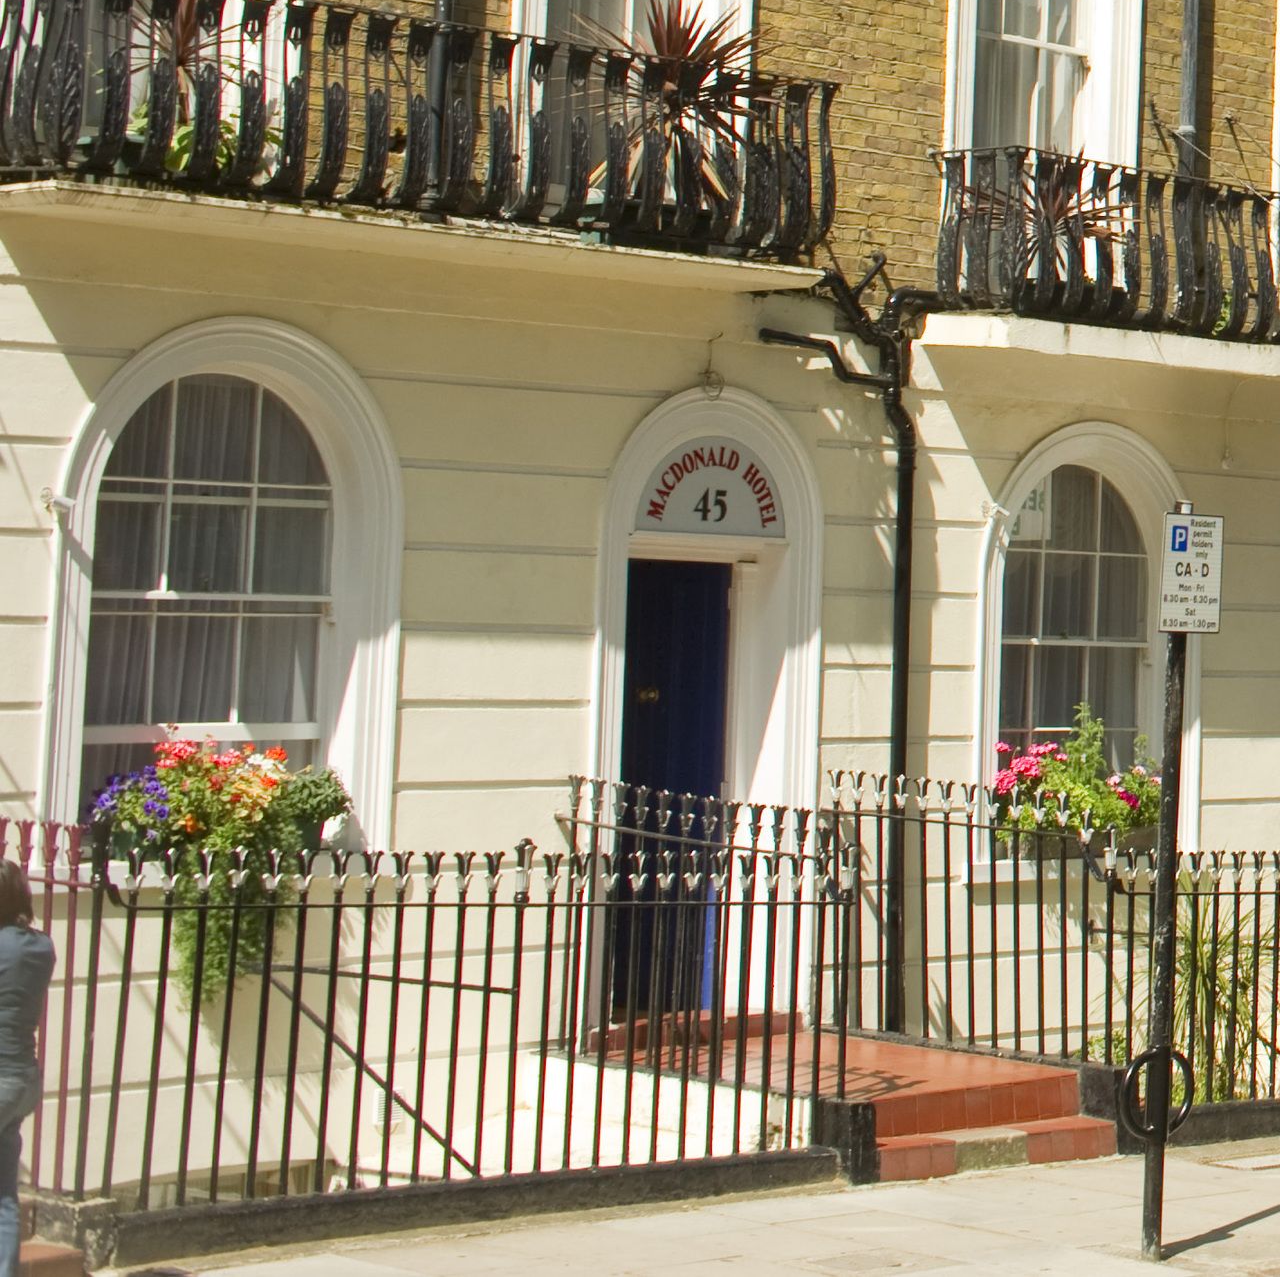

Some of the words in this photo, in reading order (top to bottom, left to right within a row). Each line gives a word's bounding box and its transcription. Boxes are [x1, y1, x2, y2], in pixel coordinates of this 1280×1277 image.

[647, 446, 740, 522] MACDONALD
[742, 463, 777, 528] HOTEL
[694, 487, 728, 522] 45
[1190, 518, 1217, 528] Resident
[1191, 540, 1213, 549] holders
[1195, 550, 1209, 560] only
[1175, 562, 1192, 577] CA
[1201, 563, 1210, 578] D
[1178, 583, 1192, 592] Mon
[1196, 584, 1206, 593] Fri
[1185, 607, 1196, 616] Sat
